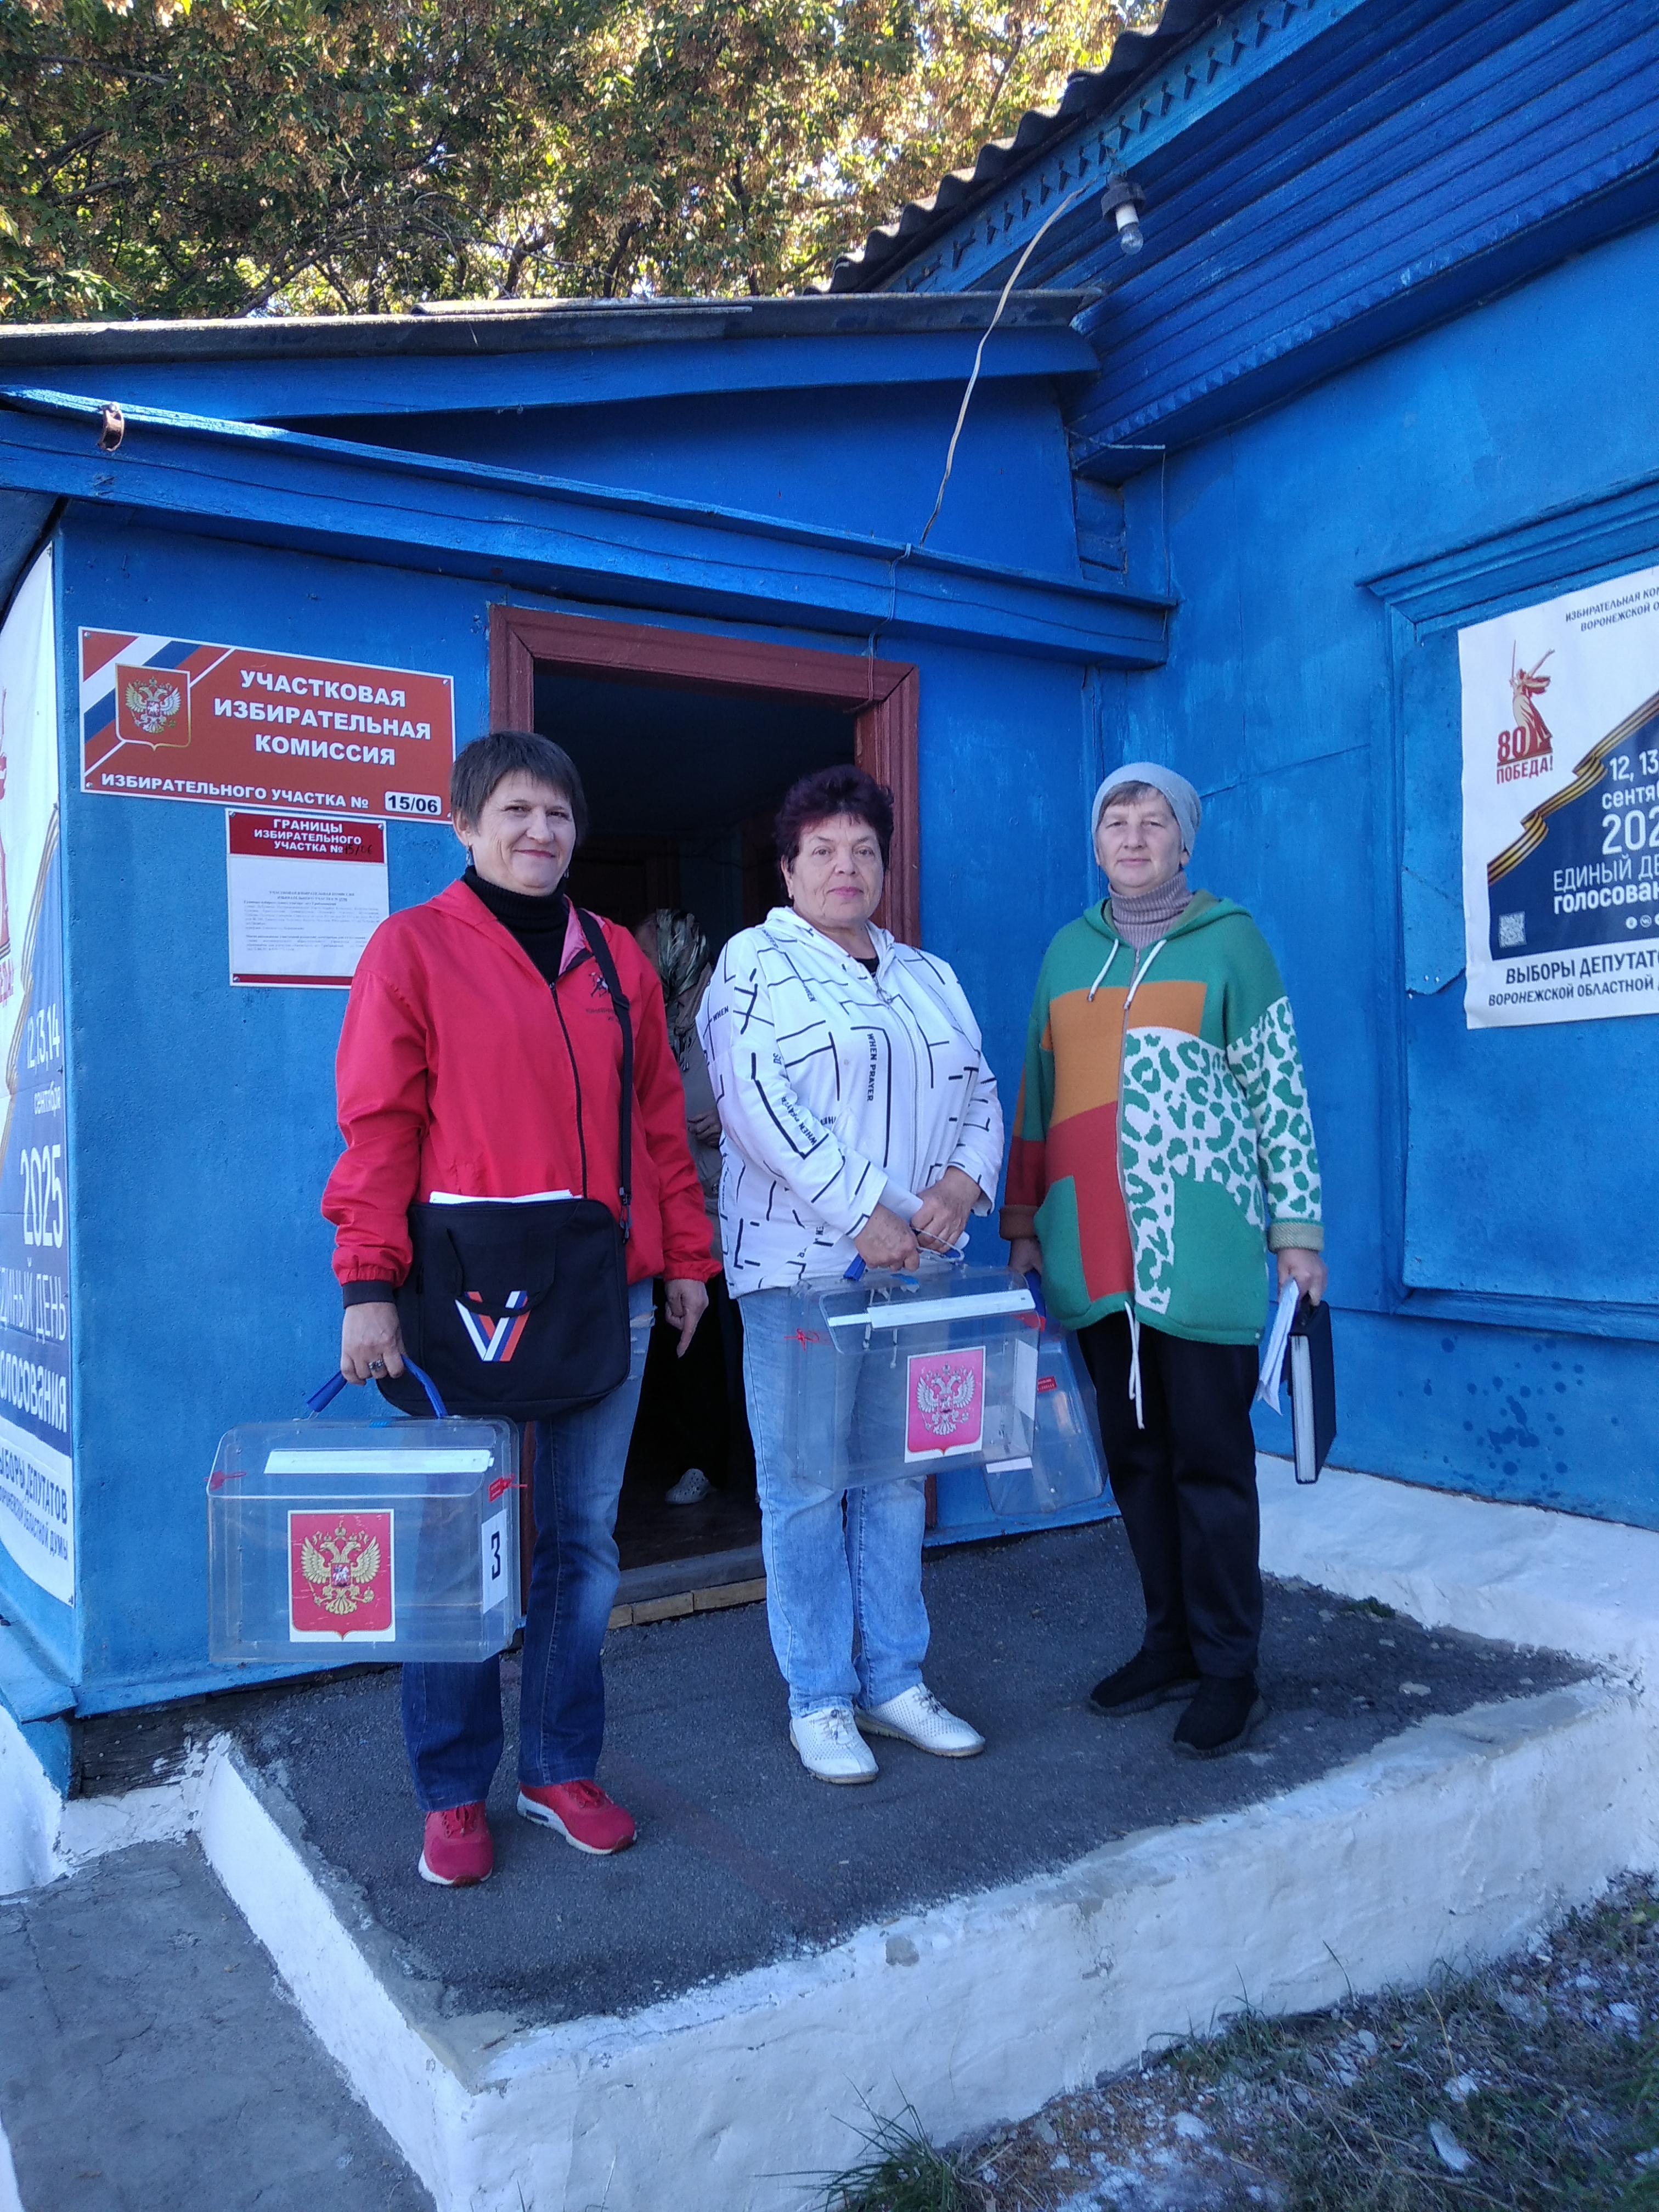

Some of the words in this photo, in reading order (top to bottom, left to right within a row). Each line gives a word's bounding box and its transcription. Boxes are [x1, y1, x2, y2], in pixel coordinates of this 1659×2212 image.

[1565, 591, 1640, 622] ИЗБИРАТЕЛЬНАЯ
[1581, 602, 1650, 632] ВОРОНЕЖСКОЙ
[240, 669, 407, 708] УЧАСТКОВАЯ
[214, 699, 431, 740] ИЗБИРАТЕЛЬНАЯ
[255, 734, 396, 766] КОМИССИЯ
[1498, 726, 1526, 761] 80
[1497, 755, 1553, 785] ПОБЕДА!
[1610, 755, 1634, 782] 12,
[101, 773, 267, 801] ИЗБИРАТЕЛЬНОГО
[272, 788, 346, 808] УЧАСТКА
[350, 795, 369, 810] №
[387, 794, 439, 814] 15/06
[1602, 780, 1659, 810] сентя
[254, 829, 362, 845] ИЗБИРАТЕЛЬНОГО
[273, 819, 342, 834] ГРАНИЦЫ
[274, 840, 326, 853] УЧАСТКА
[1553, 854, 1632, 893] ЕДИНЫЙ
[1506, 960, 1575, 985] ВЫБОРЫ
[1580, 949, 1659, 978] ДЕПУТАТ
[1488, 984, 1574, 1007] ВОРОНЕЖСКОЙ
[1577, 974, 1654, 997] ОБЛАСТНОЙ
[712, 1005, 729, 1022] WHEN
[47, 1003, 60, 1060] 14
[867, 1033, 877, 1060] WHEN
[867, 1064, 876, 1102] PRAYER
[20, 1144, 64, 1249] 2025
[36, 1274, 67, 1345] ДЕНЬ
[25, 1463, 67, 1525] ДЕПУТАТОВ
[491, 1530, 501, 1581] 3
